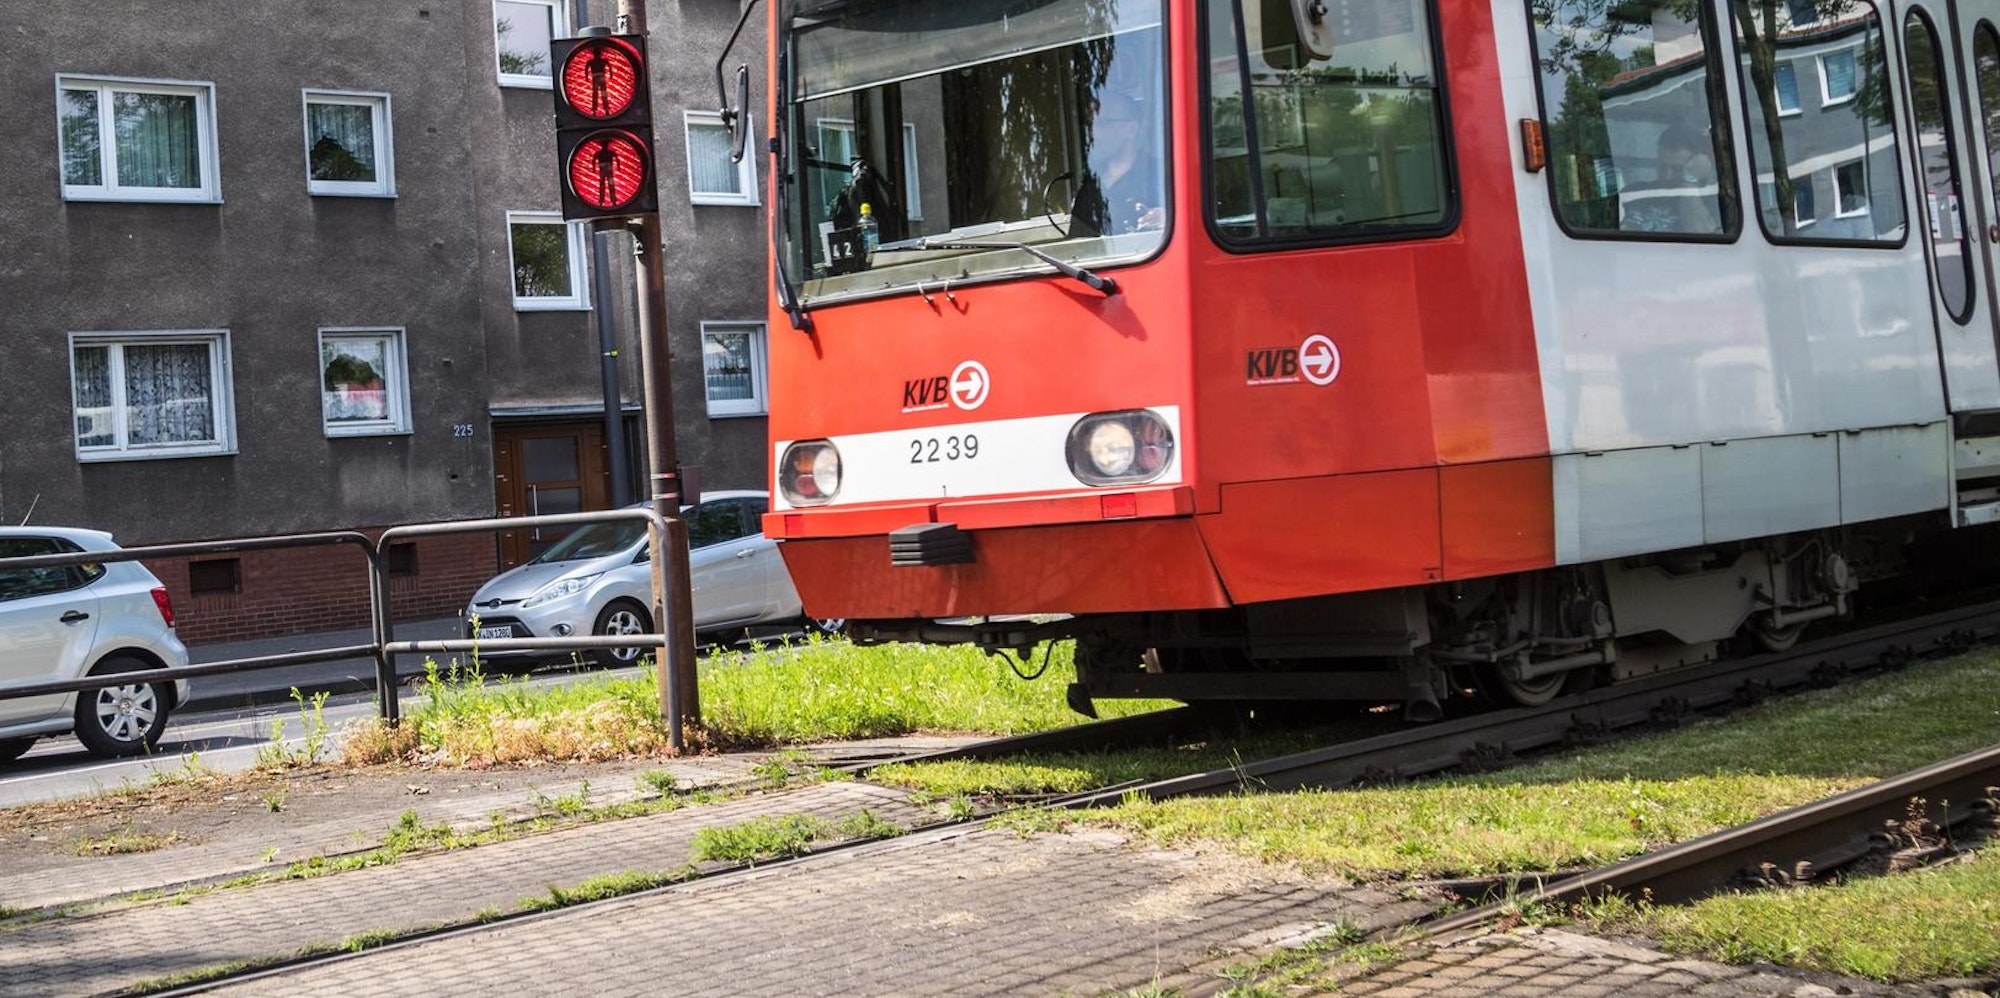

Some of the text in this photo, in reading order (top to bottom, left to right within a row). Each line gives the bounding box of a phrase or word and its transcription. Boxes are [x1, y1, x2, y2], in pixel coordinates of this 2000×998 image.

[1247, 349, 1298, 378] KVB
[903, 376, 949, 407] KVB
[453, 424, 474, 437] 225
[911, 434, 978, 463] 2239
